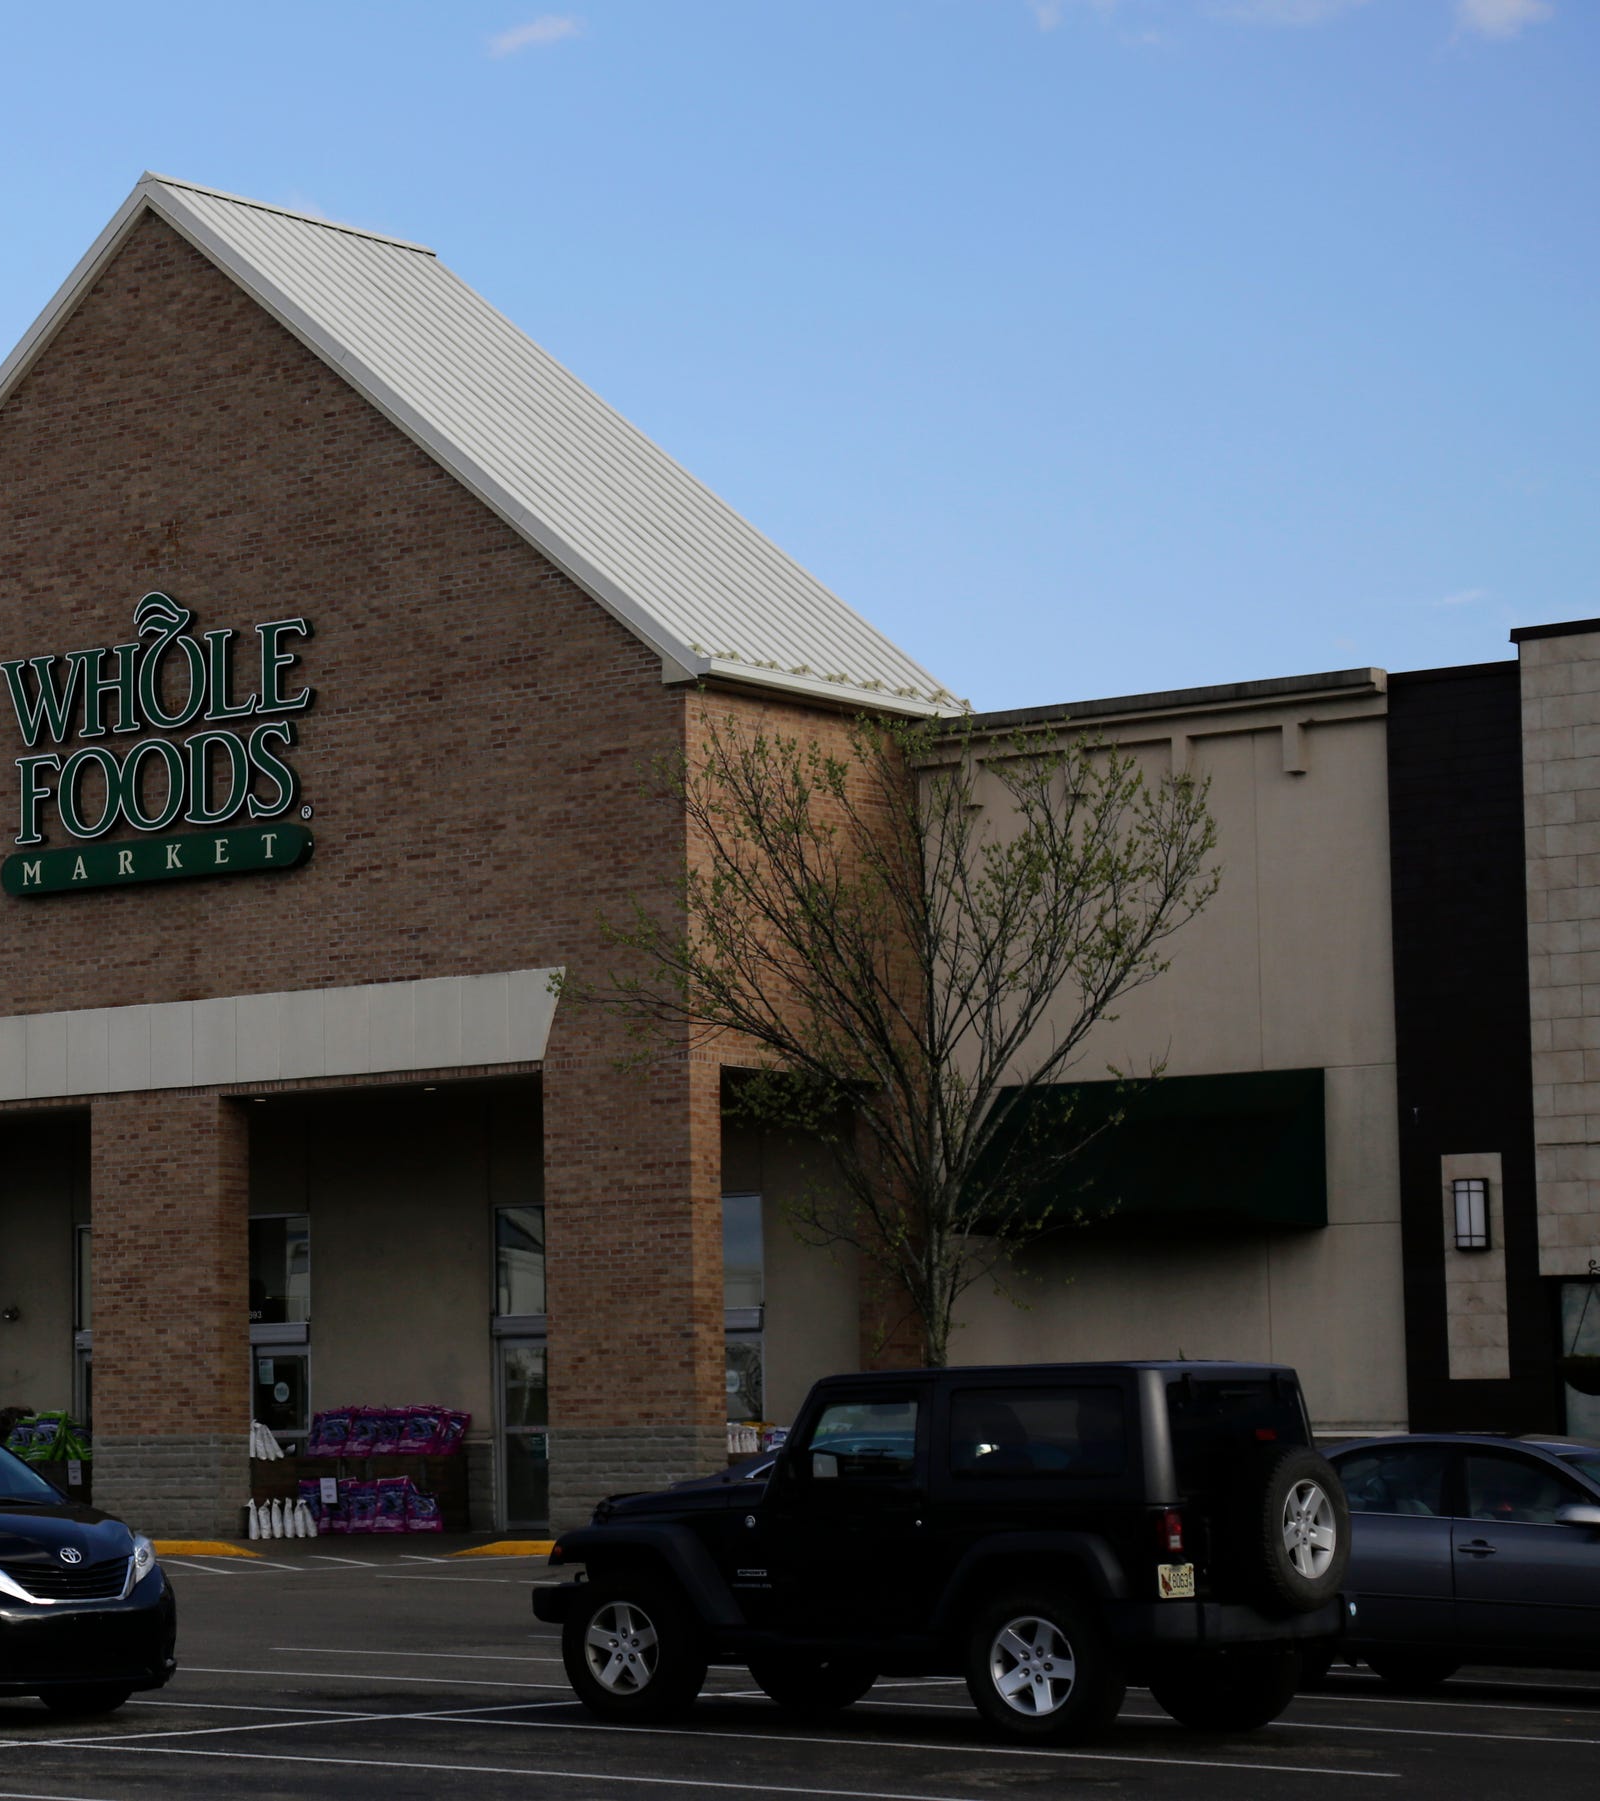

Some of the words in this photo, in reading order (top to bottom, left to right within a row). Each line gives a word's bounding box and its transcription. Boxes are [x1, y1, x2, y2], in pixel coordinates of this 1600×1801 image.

[0, 592, 310, 746] WHOLE
[15, 721, 294, 844] FOODS
[22, 833, 278, 885] MARKET
